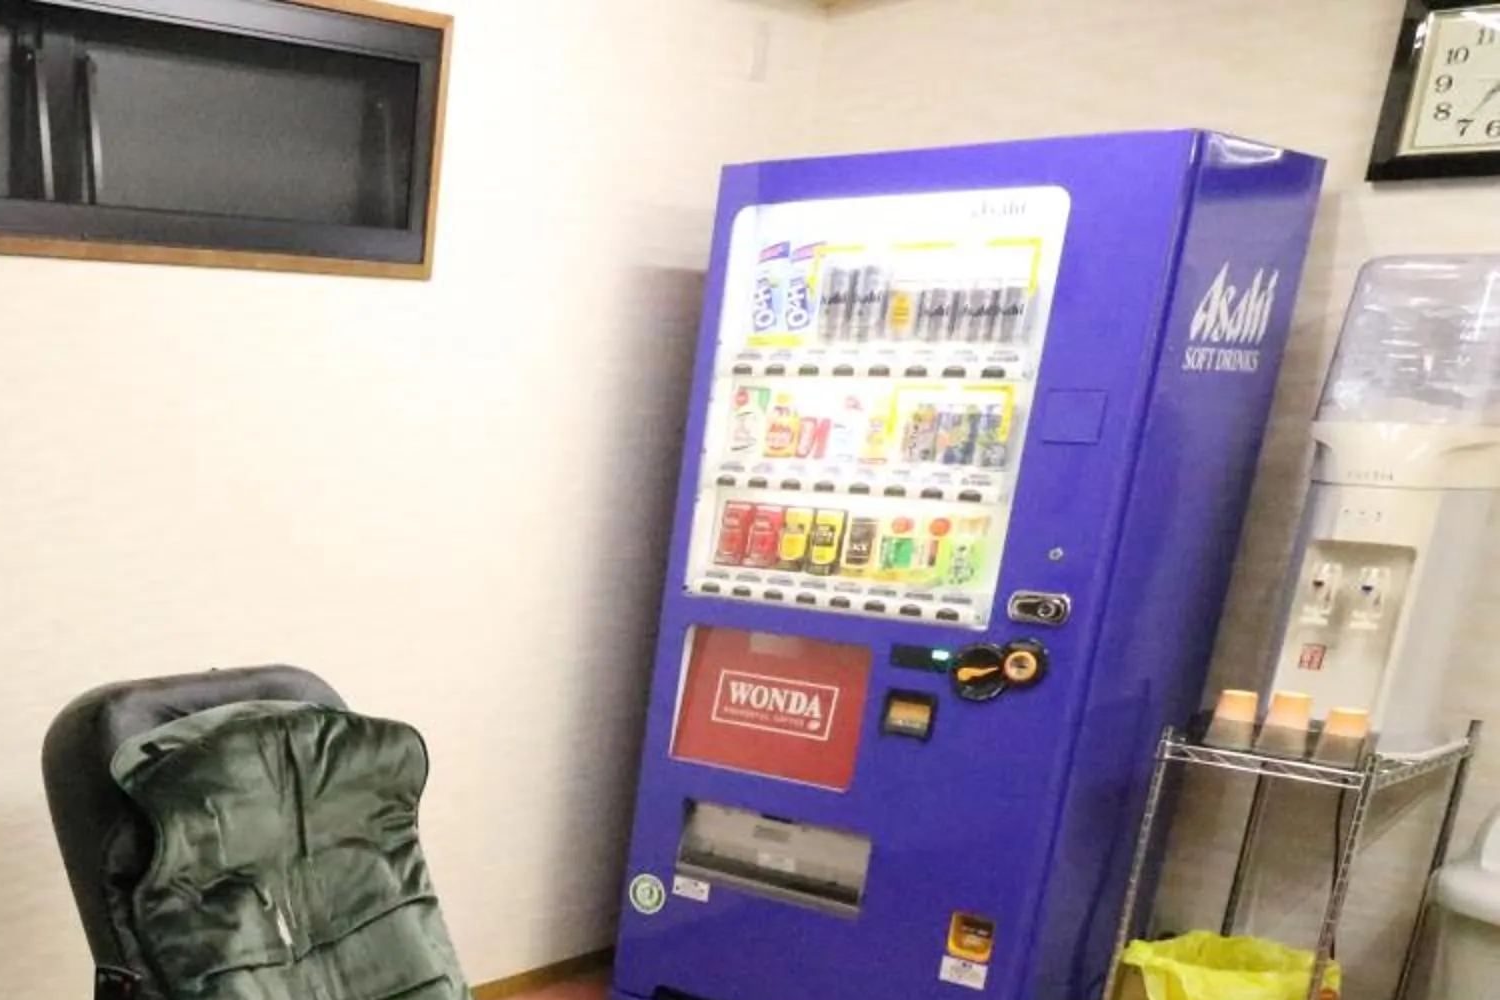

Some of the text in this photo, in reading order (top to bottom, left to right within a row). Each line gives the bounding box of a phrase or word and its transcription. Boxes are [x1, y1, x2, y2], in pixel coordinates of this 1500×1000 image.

[1446, 46, 1470, 66] 10
[1434, 74, 1453, 94] 9
[1433, 101, 1453, 122] 8
[1457, 118, 1475, 137] 7
[1485, 119, 1500, 139] 6
[1190, 261, 1280, 345] Asahi
[1181, 346, 1261, 373] SOFT DRINKS
[729, 680, 822, 719] WONDA
